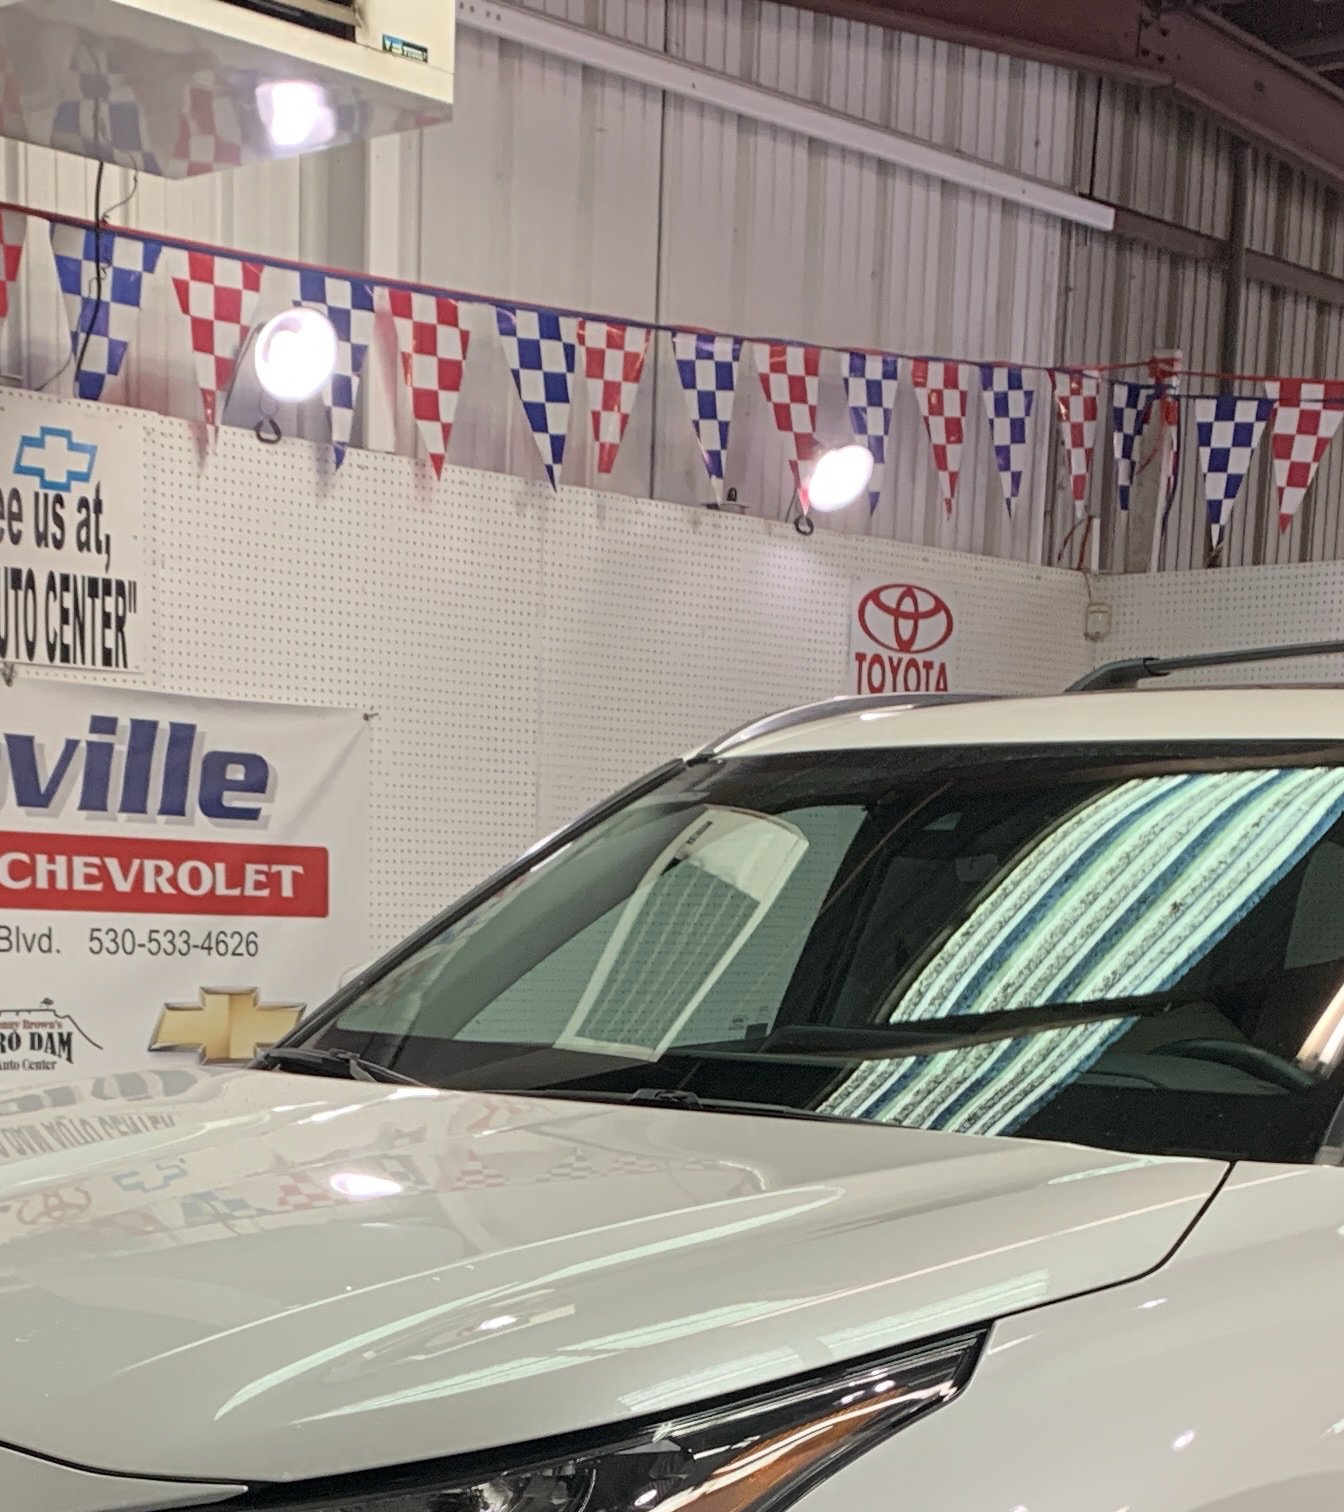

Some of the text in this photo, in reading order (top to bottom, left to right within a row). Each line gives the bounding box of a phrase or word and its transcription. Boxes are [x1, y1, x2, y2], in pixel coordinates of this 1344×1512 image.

[34, 491, 66, 551] us
[75, 480, 111, 574] at,
[45, 570, 137, 669] CENTER"
[855, 652, 948, 695] TOYOTA
[88, 927, 259, 957] 530-533-4626
[22, 1058, 57, 1070] Center
[29, 1031, 73, 1064] DAM
